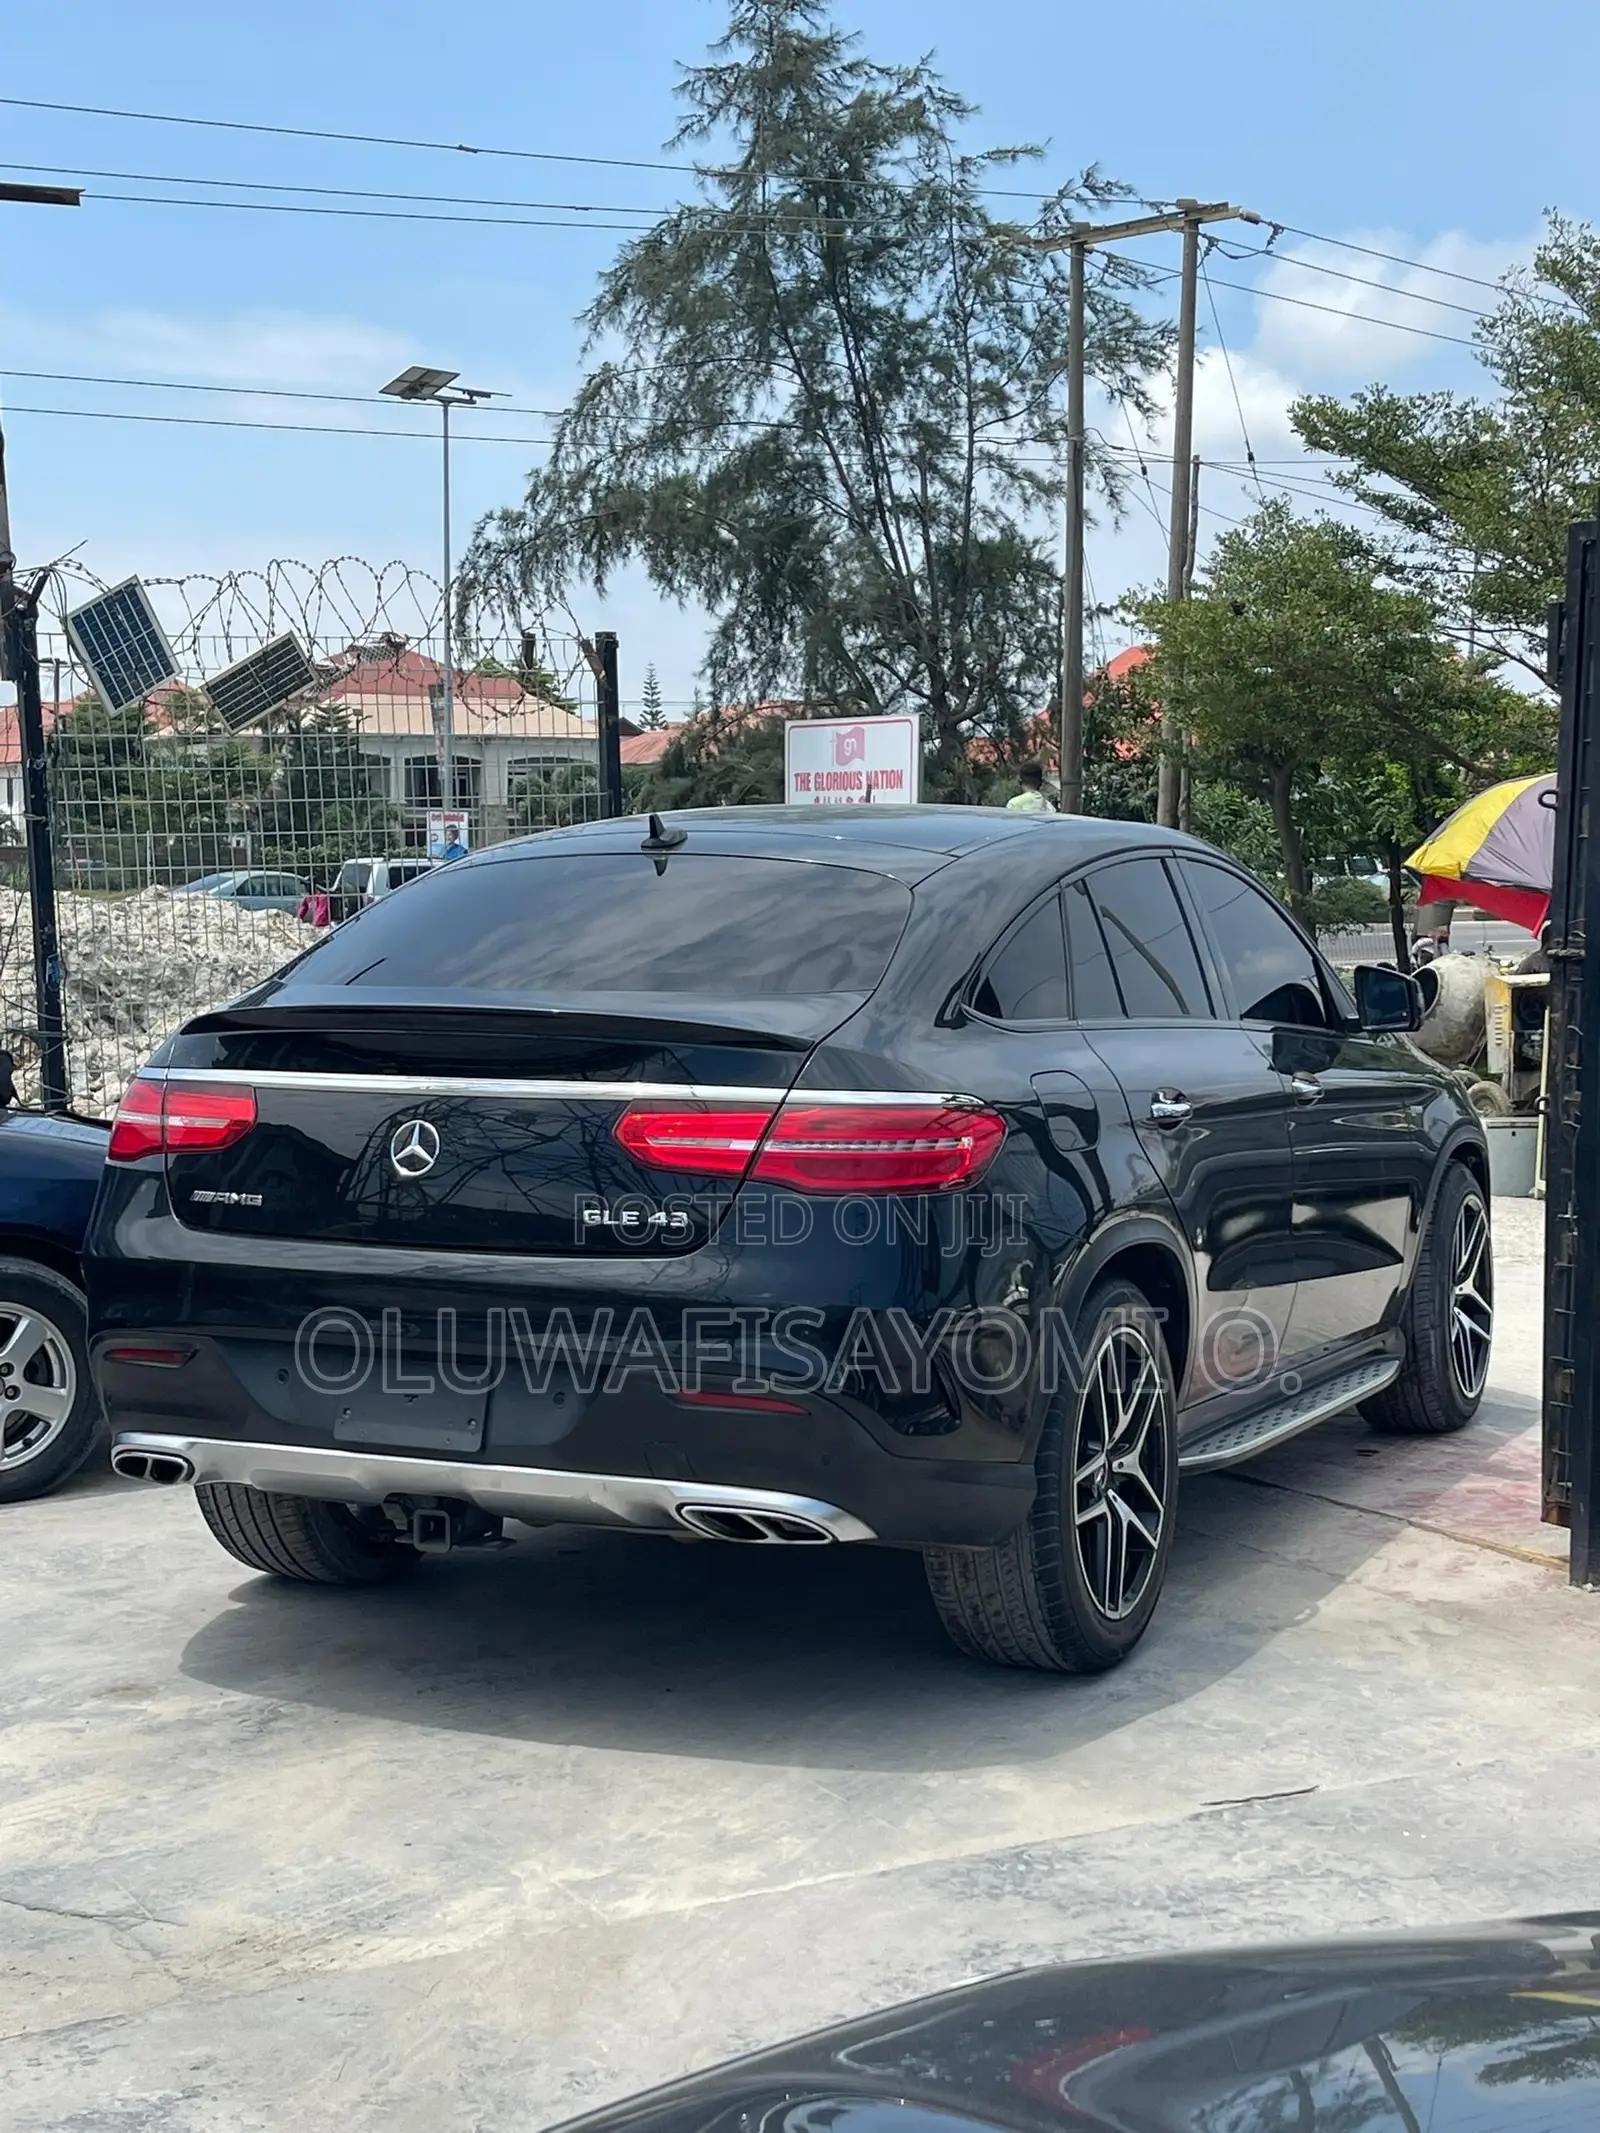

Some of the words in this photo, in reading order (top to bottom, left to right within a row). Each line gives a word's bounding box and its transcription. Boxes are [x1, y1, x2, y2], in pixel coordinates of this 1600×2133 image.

[794, 772, 811, 792] THE
[814, 770, 863, 792] GLORIOUS
[866, 769, 904, 791] NATION
[213, 1191, 263, 1207] AMG
[583, 1209, 640, 1226] GLE
[648, 1211, 689, 1227] 43
